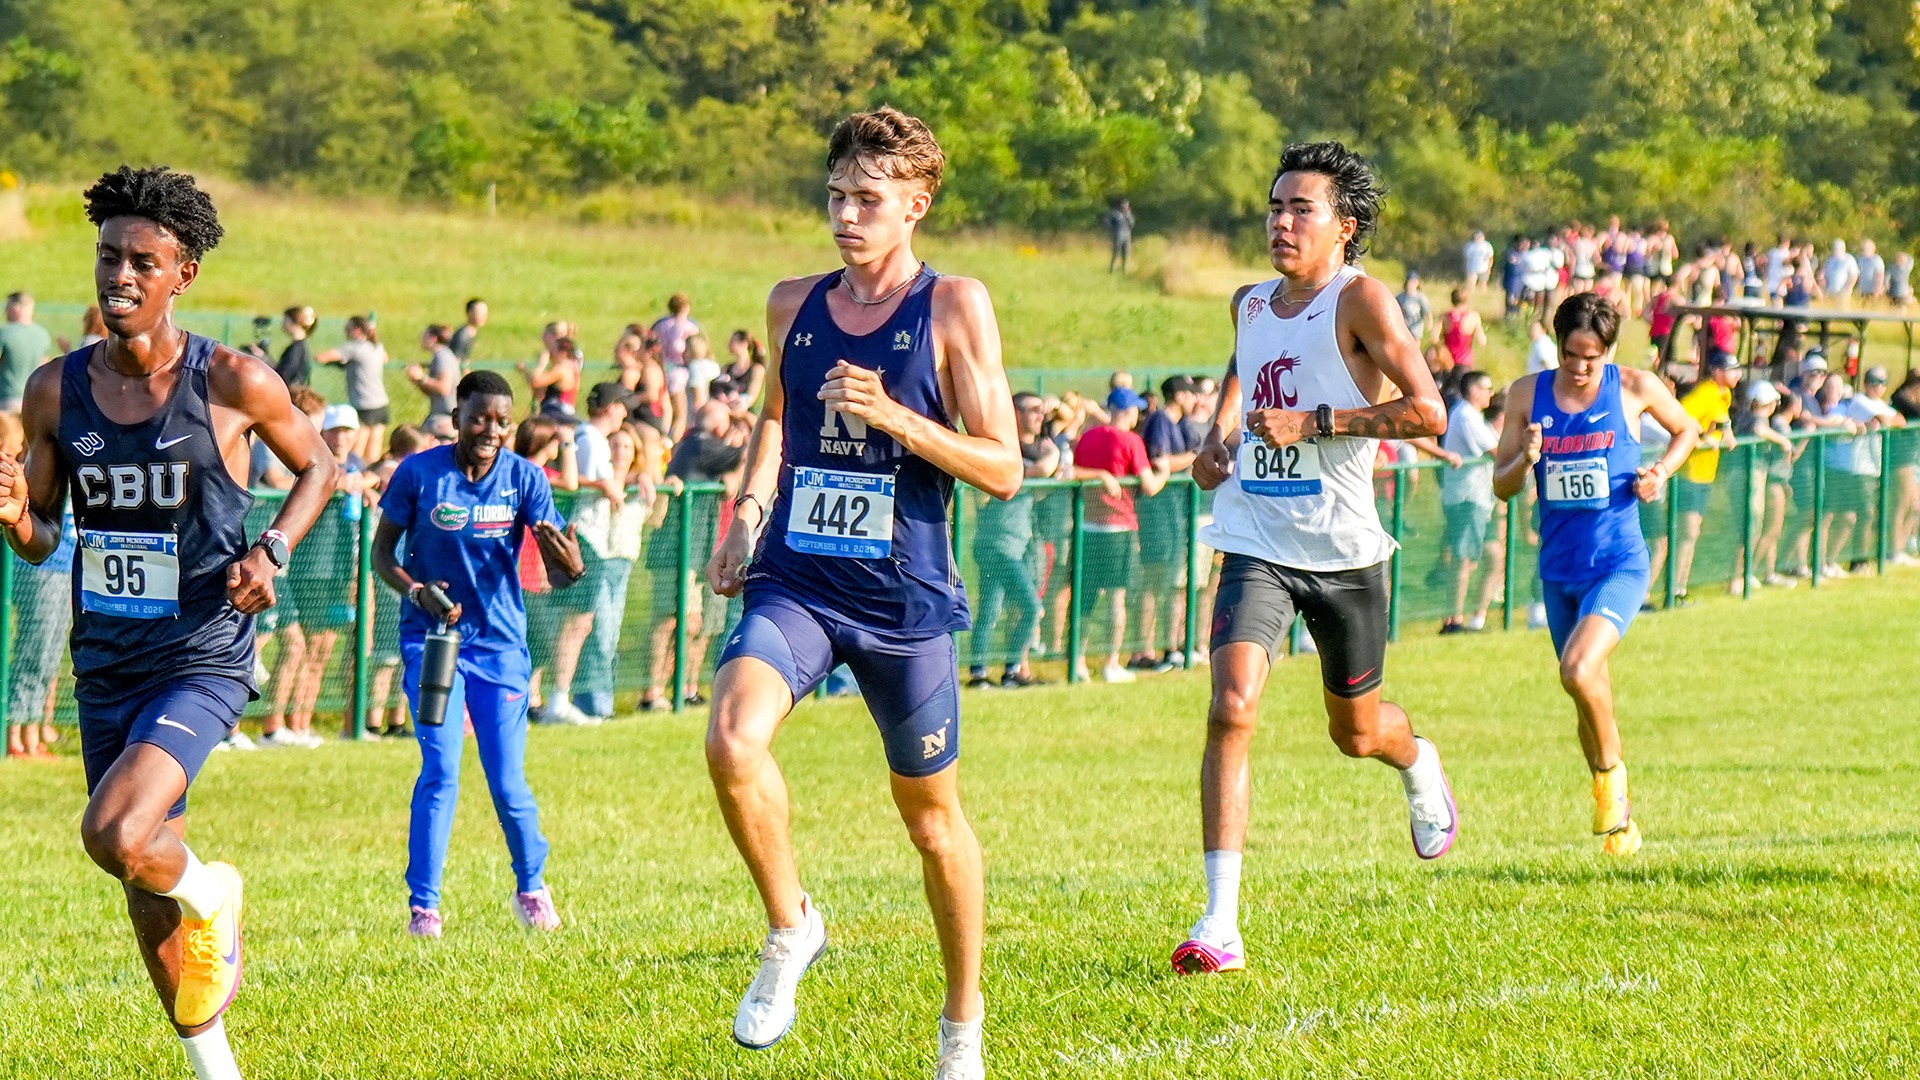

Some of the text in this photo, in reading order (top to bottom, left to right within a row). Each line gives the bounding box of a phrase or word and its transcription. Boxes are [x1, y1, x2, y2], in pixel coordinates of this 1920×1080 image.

[820, 439, 866, 456] NAVY
[1543, 430, 1615, 453] FLORIDA
[1254, 445, 1302, 479] 842
[78, 461, 190, 510] CBU
[807, 472, 824, 486] JM
[1559, 473, 1595, 498] 156
[473, 504, 515, 522] FLORIDA
[807, 493, 870, 537] 442
[89, 535, 106, 548] JM
[797, 540, 837, 551] SEPTEMBER
[853, 545, 876, 553] 2026
[104, 554, 146, 597] 95
[143, 605, 164, 614] 2026
[921, 726, 947, 755] N
[923, 745, 947, 760] NAVY
